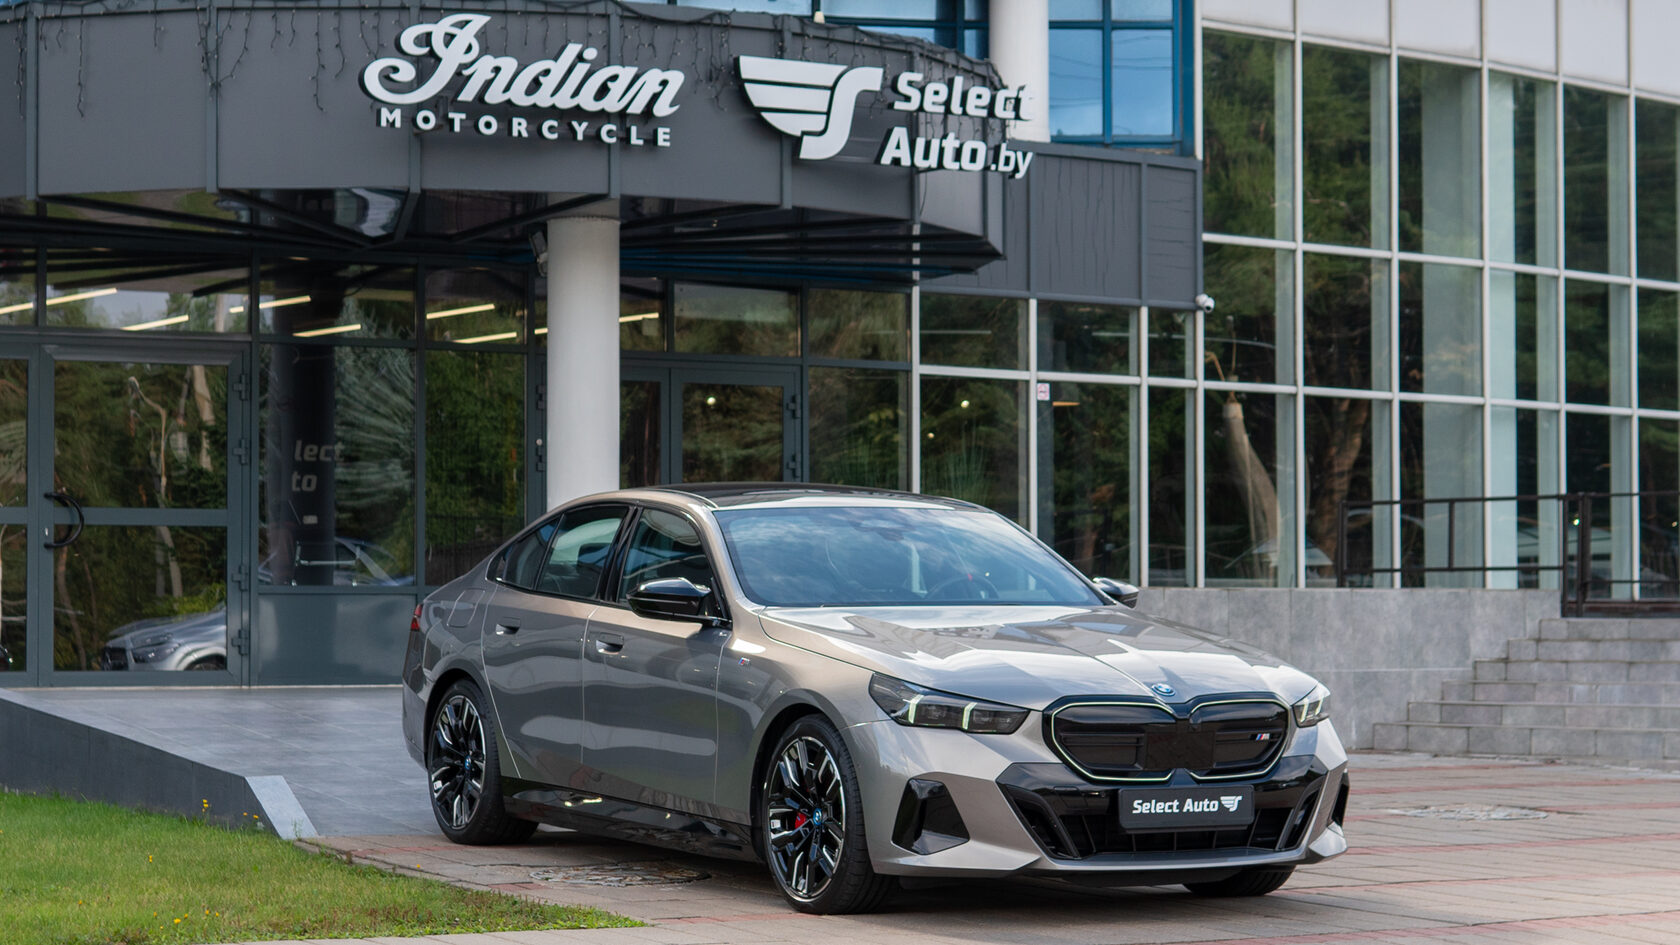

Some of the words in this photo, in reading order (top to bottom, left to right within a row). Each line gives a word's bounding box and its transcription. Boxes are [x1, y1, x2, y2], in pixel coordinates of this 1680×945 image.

[363, 13, 685, 118] Indian
[893, 71, 1035, 120] Select
[380, 107, 671, 147] MOTORCYCLE
[880, 126, 1034, 179] Auto.by
[1132, 799, 1180, 814] Select
[1182, 798, 1219, 813] Auto
